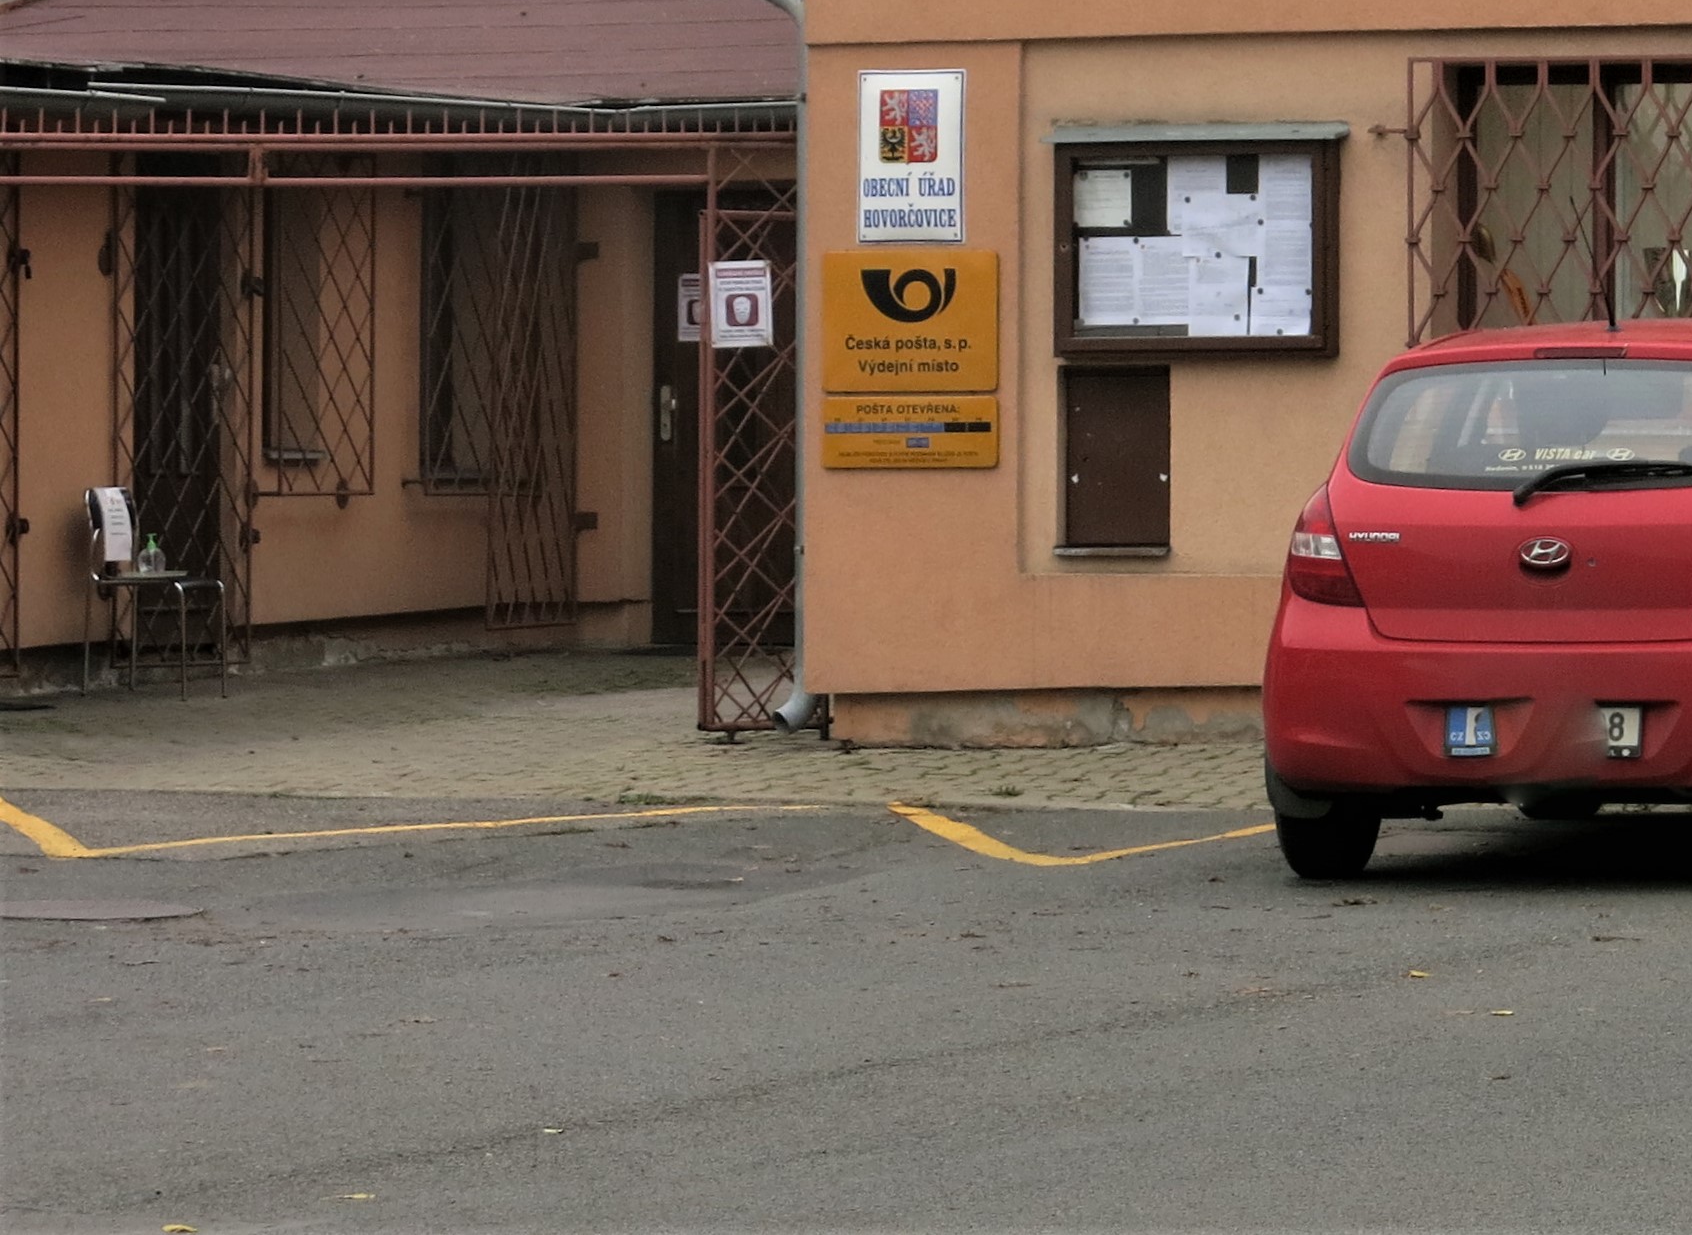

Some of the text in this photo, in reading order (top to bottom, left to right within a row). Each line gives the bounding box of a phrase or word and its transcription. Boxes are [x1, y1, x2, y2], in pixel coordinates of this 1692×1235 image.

[863, 171, 956, 198] OBECNÍ ÚŘAD
[863, 202, 957, 228] HOVORČOVICE
[844, 334, 891, 350] Česká
[895, 335, 941, 353] pošta,
[858, 358, 959, 376] Výdejní místo
[856, 402, 961, 415] POŠTA OTEVŘENA:
[1534, 448, 1596, 460] VISTA car
[1450, 731, 1464, 741] CZ
